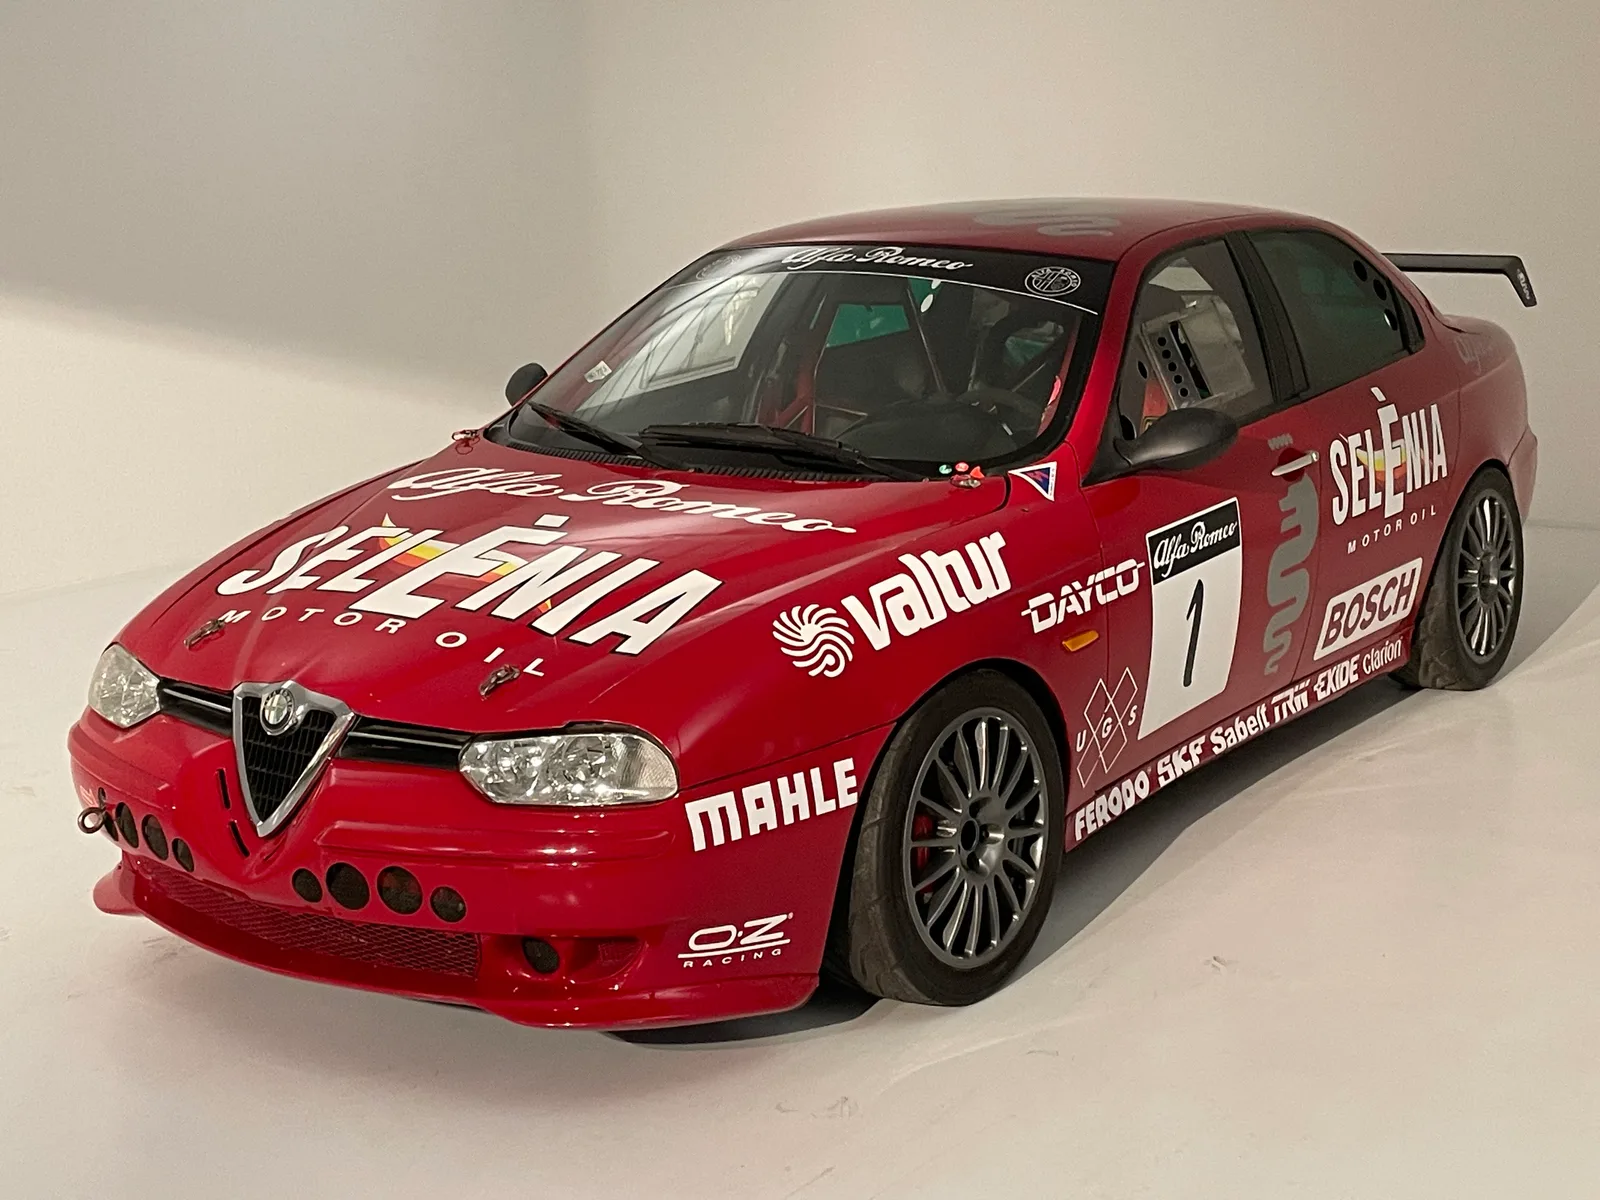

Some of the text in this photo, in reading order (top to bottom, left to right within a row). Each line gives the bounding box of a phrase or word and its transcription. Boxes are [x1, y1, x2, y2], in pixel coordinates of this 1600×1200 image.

[782, 246, 973, 270] Alfa Romeo
[387, 467, 856, 533] Alfa Romeo
[1347, 505, 1436, 554] MOTOR OIL
[1153, 521, 1238, 578] Alfa Romeo
[1021, 558, 1145, 633] DAYCO
[1321, 566, 1417, 648] BOSCH
[220, 606, 545, 677] MOTOR OIL
[1183, 579, 1204, 687] 1
[1075, 637, 1402, 841] FERODO SKF Sabelt TRW EXIDE Clarion
[684, 757, 858, 852] MAHLE
[683, 948, 781, 968] RACING
